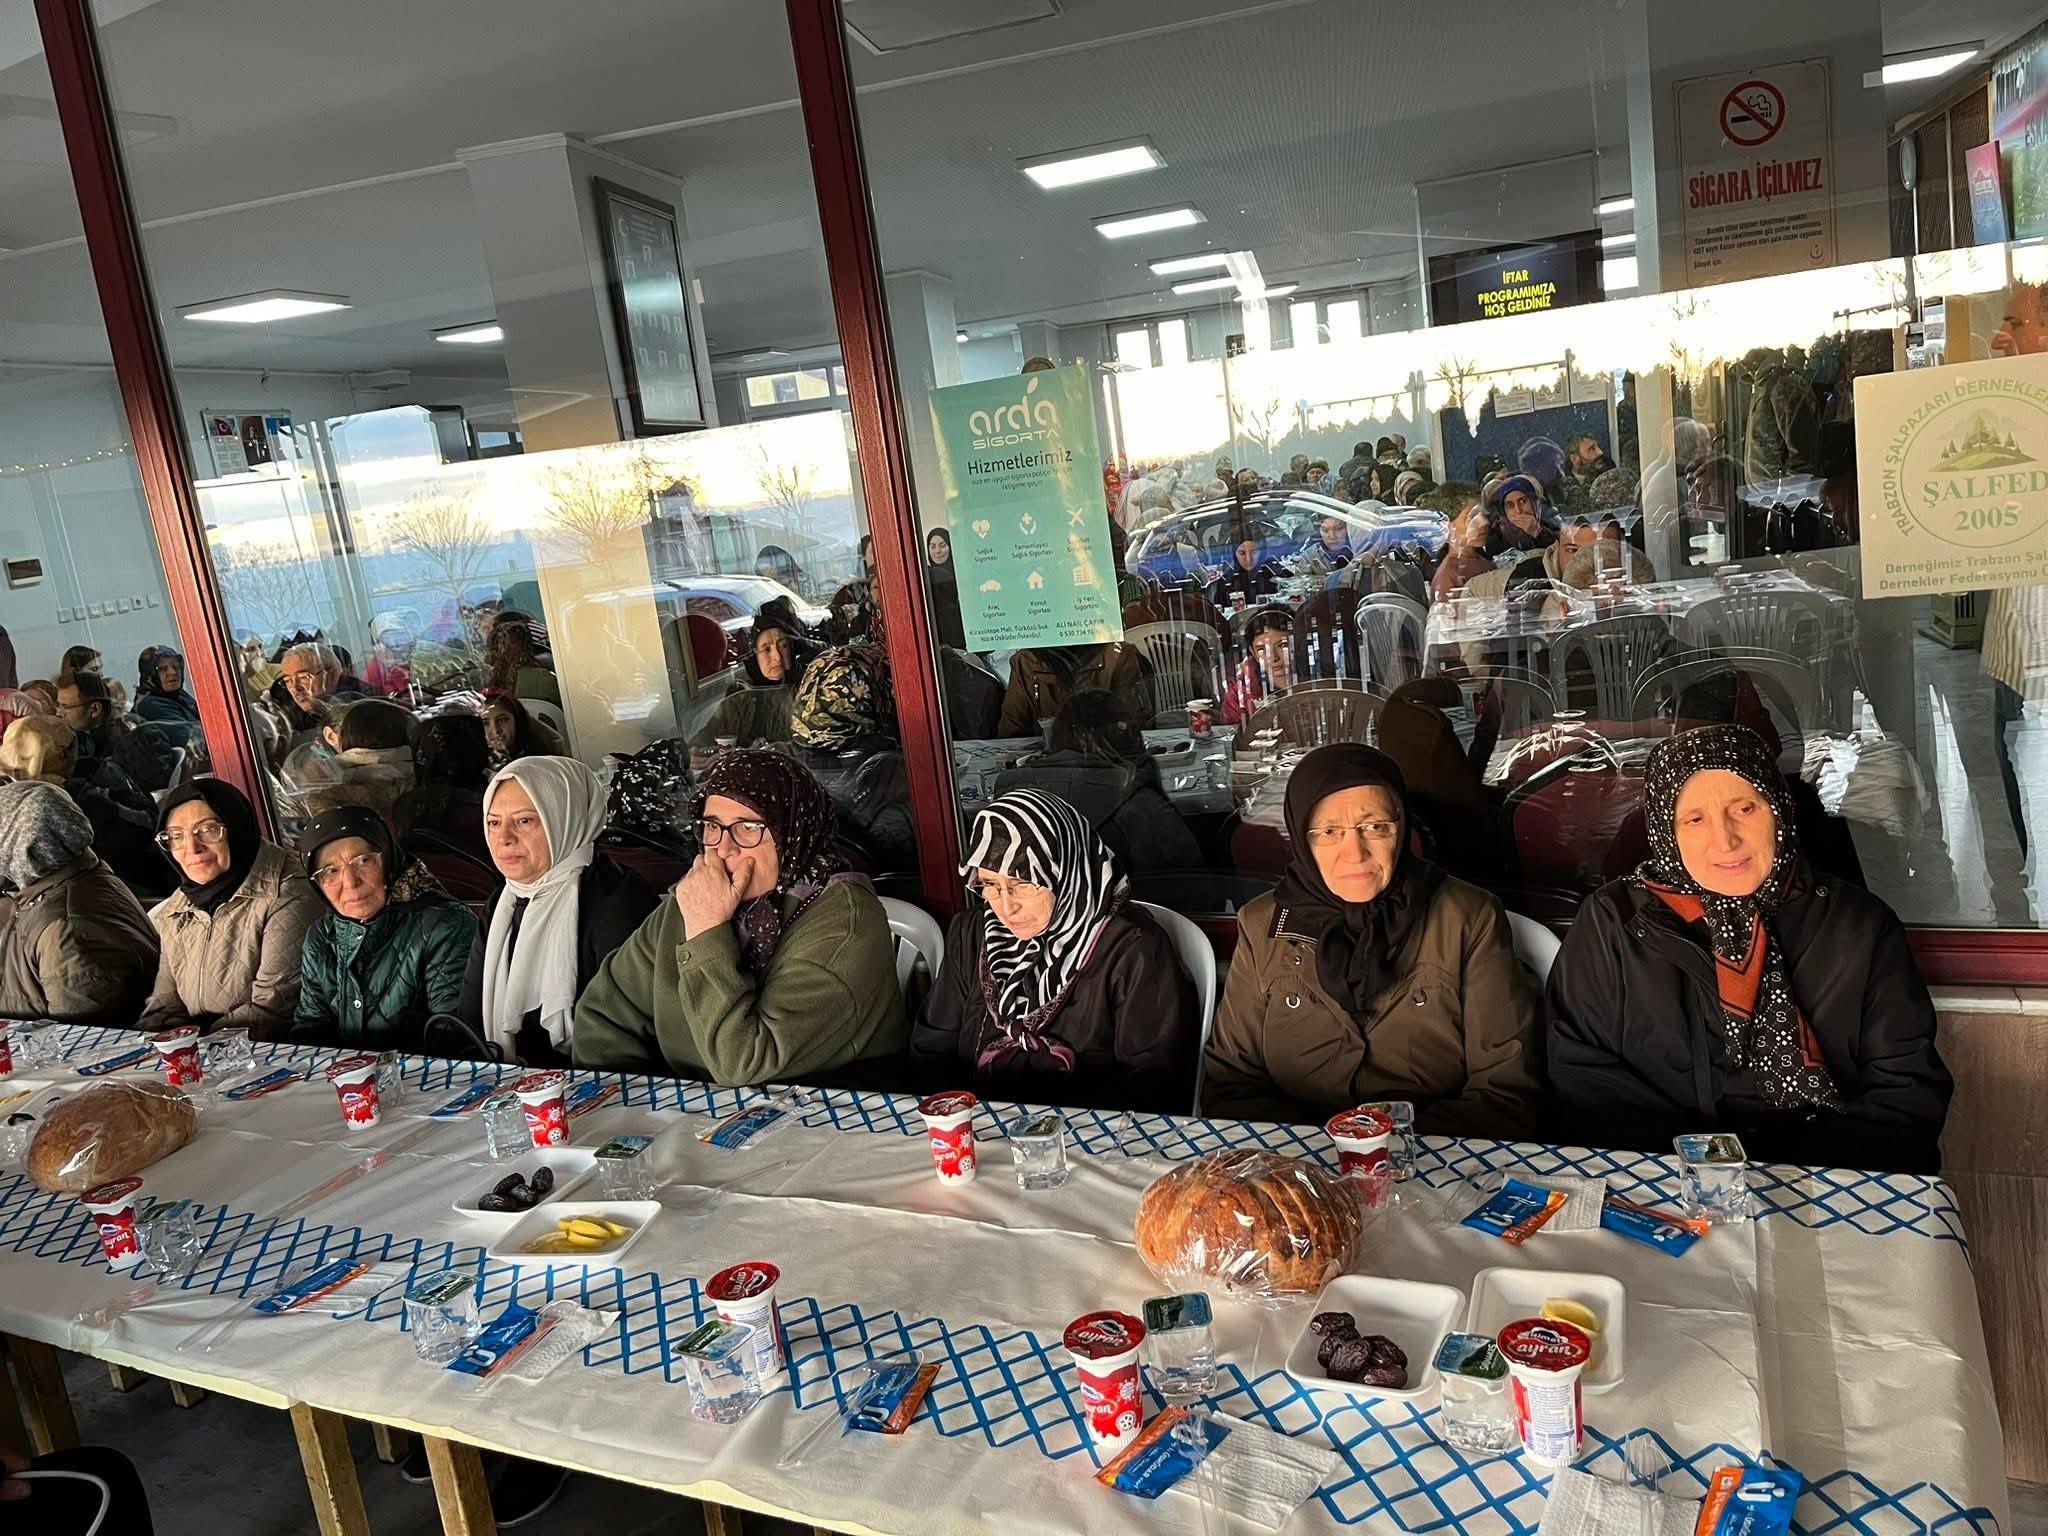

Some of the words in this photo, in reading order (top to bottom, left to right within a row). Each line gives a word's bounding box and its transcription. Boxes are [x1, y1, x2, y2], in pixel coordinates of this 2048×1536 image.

[1689, 170, 1752, 208] SİGARA
[1756, 158, 1823, 201] İÇİLMEZ
[1503, 269, 1528, 284] İFTAR
[1478, 282, 1556, 305] PROGRAMIMIZA
[1485, 302, 1505, 317] HOŞ
[1507, 294, 1551, 313] GELDİNİZ
[969, 396, 1059, 436] arda
[1886, 391, 1950, 464] ŞALPAZARI
[968, 448, 1072, 475] Hizmetlerimiz
[1883, 468, 1914, 536] TRABZON
[1923, 471, 2048, 508] ŞALFED
[1955, 504, 2019, 532] 2005
[1885, 559, 1962, 573] Derneğimiz
[1967, 554, 2021, 567] Trabzon
[1879, 576, 1946, 590] Dernekler
[1950, 570, 2038, 584] Federasyonu
[1516, 1344, 1572, 1358] ayran
